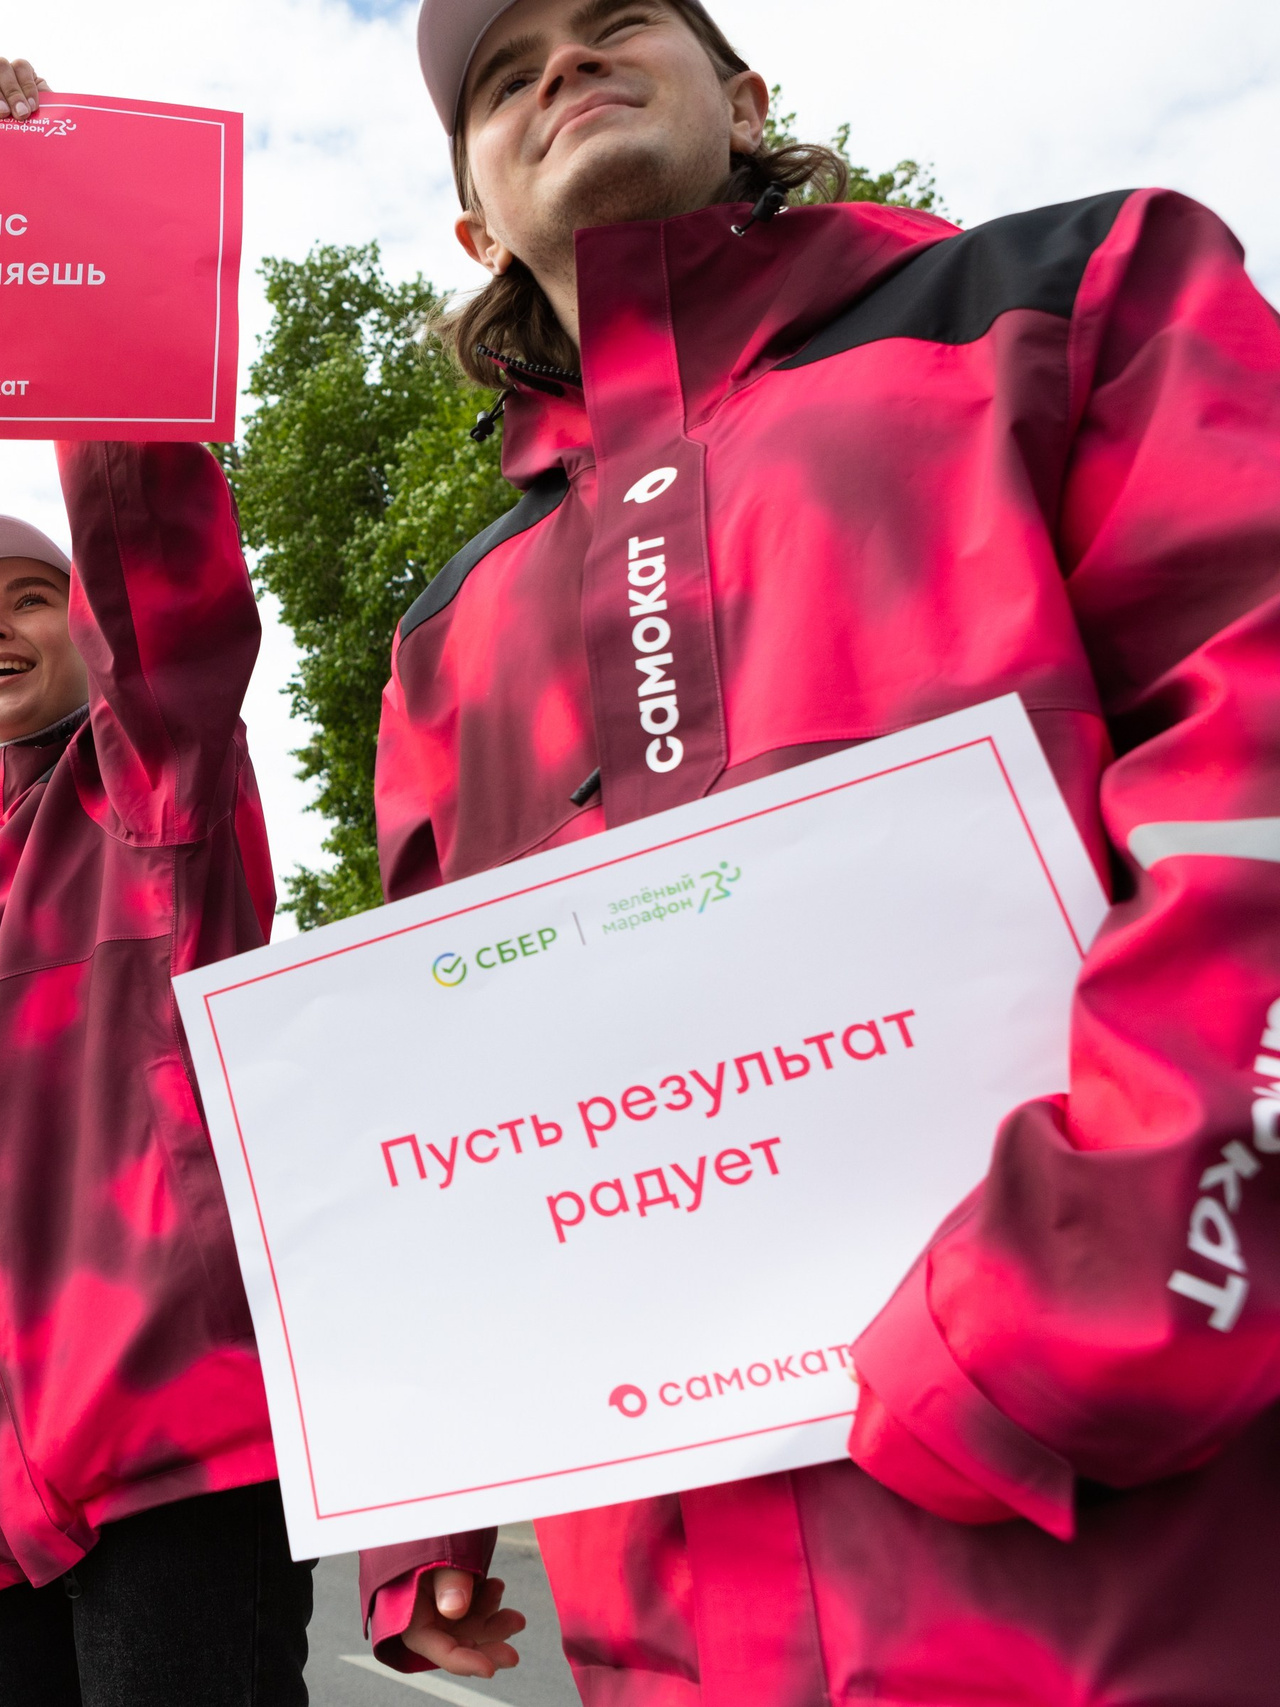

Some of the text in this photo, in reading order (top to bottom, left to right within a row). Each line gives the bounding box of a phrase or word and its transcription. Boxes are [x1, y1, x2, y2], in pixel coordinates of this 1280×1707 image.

[627, 536, 684, 773] самокат
[601, 898, 694, 935] марафон
[607, 873, 696, 915] зелёный
[475, 926, 557, 970] СБЕР
[379, 1006, 920, 1191] Пусть результат
[543, 1134, 785, 1243] радует
[658, 1343, 849, 1406] самокат
